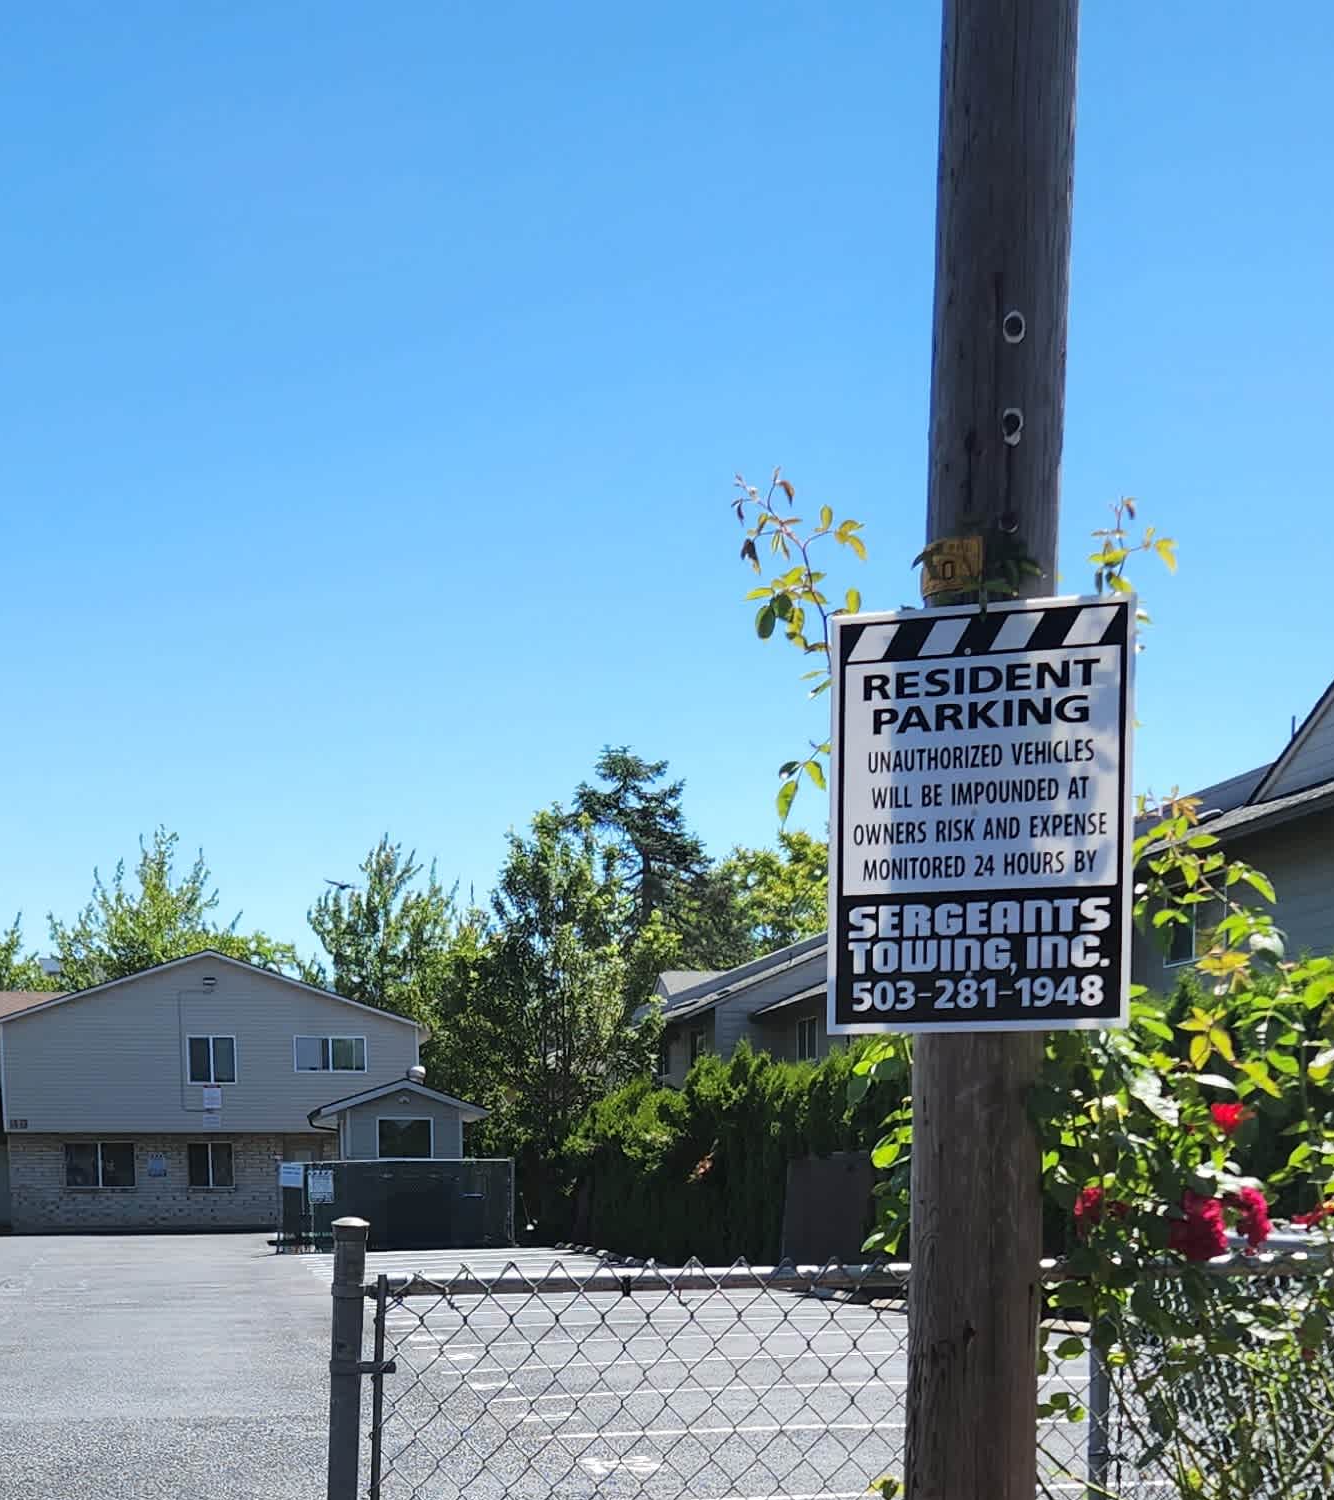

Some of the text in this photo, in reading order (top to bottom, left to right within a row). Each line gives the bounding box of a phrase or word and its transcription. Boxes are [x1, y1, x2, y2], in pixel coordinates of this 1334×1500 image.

[862, 657, 1101, 702] RESIDENT
[872, 694, 1091, 736] PARKING
[867, 738, 1096, 774] UNAUTHORIZED VEHICLES
[871, 775, 1090, 810] WILL BE IMPOUNDED AT
[853, 811, 1109, 846] OWNERS RISK AND EXPENSE
[862, 849, 1098, 882] MONITORED 24 HOURS BY
[847, 896, 1112, 940] SERGEANTS
[1025, 934, 1111, 971] INC.
[851, 974, 1105, 1013] 503-281-1948
